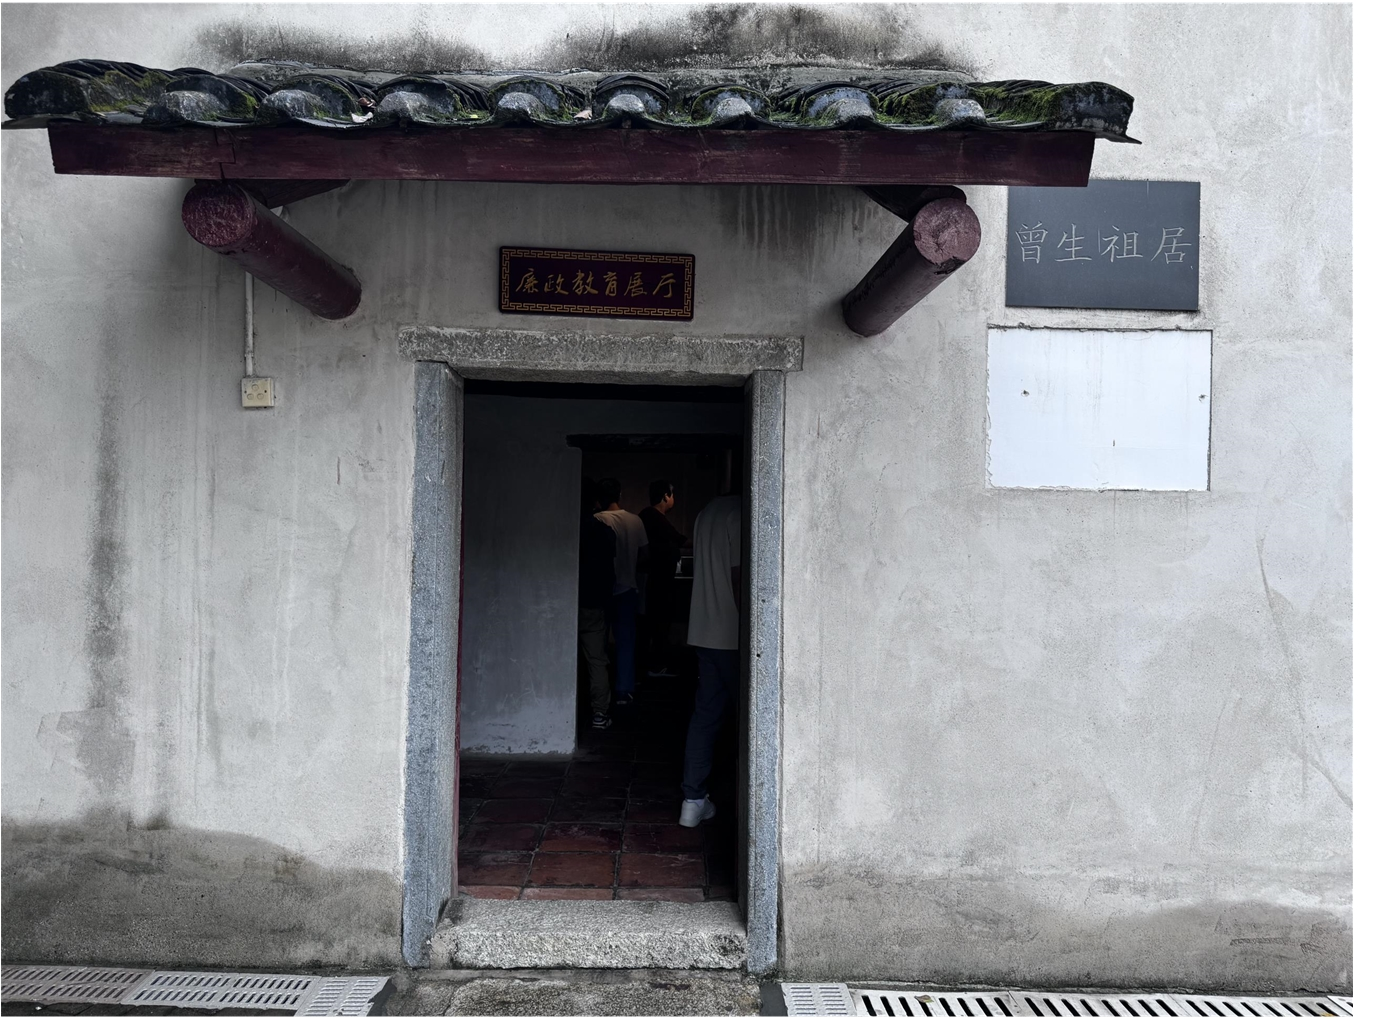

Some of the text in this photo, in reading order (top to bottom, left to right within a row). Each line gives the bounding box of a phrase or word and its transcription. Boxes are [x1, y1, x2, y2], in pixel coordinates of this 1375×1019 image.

[1014, 220, 1193, 265] 曾生祖居
[515, 267, 677, 298] 廉政教育展厅
